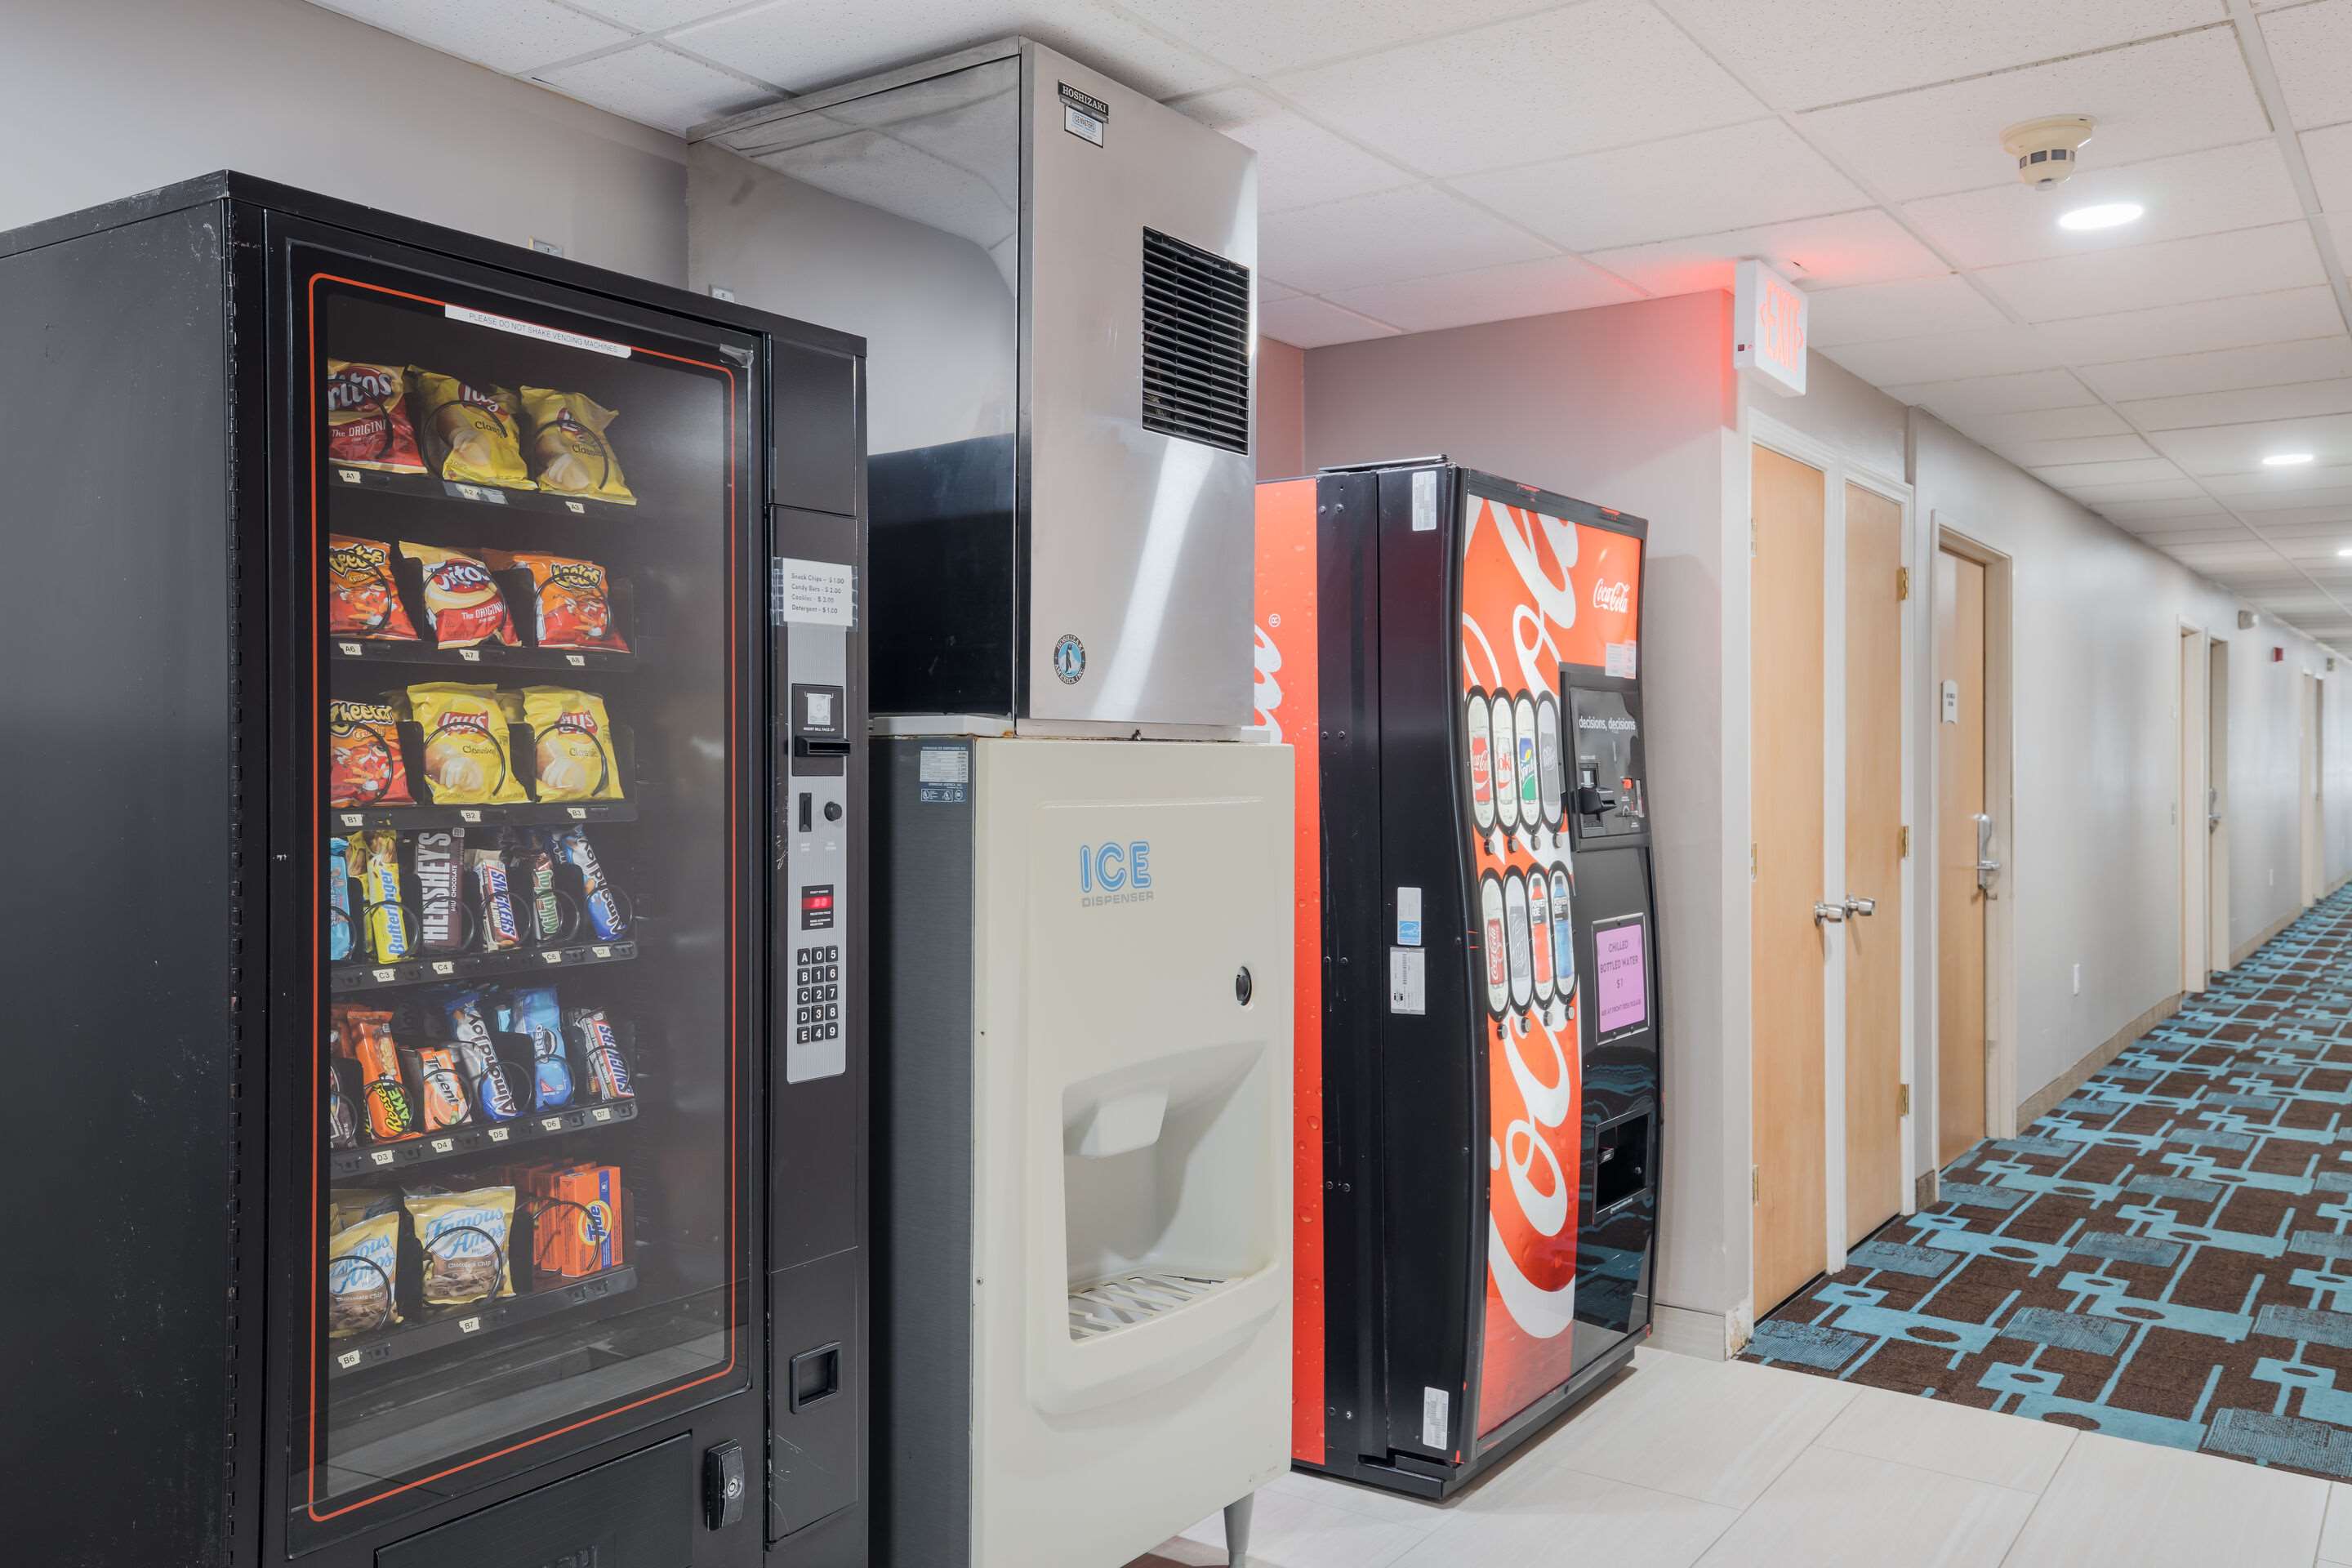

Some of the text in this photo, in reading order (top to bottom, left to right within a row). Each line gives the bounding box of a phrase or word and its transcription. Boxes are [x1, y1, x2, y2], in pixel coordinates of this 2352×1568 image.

[1062, 85, 1107, 113] HOSHIZAKI
[469, 313, 618, 353] PLEASE DO NOT SHAKE VENDING MACHINES
[328, 372, 392, 411] ritos
[349, 418, 386, 437] ORIGIN
[1593, 578, 1631, 613] Coca-Cola
[475, 602, 504, 618] ORIGIN
[345, 645, 355, 653] A6
[465, 652, 474, 660] A7
[560, 712, 595, 734] ay's
[1579, 715, 1636, 731] decisions, decisions
[347, 816, 357, 824] B1
[466, 812, 475, 820] B2
[1080, 841, 1152, 893] ICE
[1081, 891, 1155, 908] DISPENSER
[1608, 941, 1628, 953] CHILLED
[802, 950, 836, 962] A 0 5
[437, 963, 448, 972] C4
[1600, 955, 1638, 973] BOTTLED WATER
[378, 970, 390, 979] C3
[802, 969, 835, 982] B 1 6
[801, 988, 835, 1001] C 2 7
[801, 1007, 835, 1021] D 3 8
[801, 1027, 835, 1040] E 4 9
[425, 1057, 461, 1105] Trdent
[480, 1042, 517, 1116] Almond
[596, 1110, 607, 1118] D7
[546, 1120, 557, 1129] D6
[492, 1130, 504, 1138] D5
[437, 1141, 448, 1150] D4
[376, 1153, 389, 1162] D3
[425, 1207, 505, 1240] Famous
[586, 1205, 608, 1242] Tde
[444, 1225, 506, 1258] Amos
[464, 1321, 474, 1330] B7
[342, 1354, 355, 1365] B6
